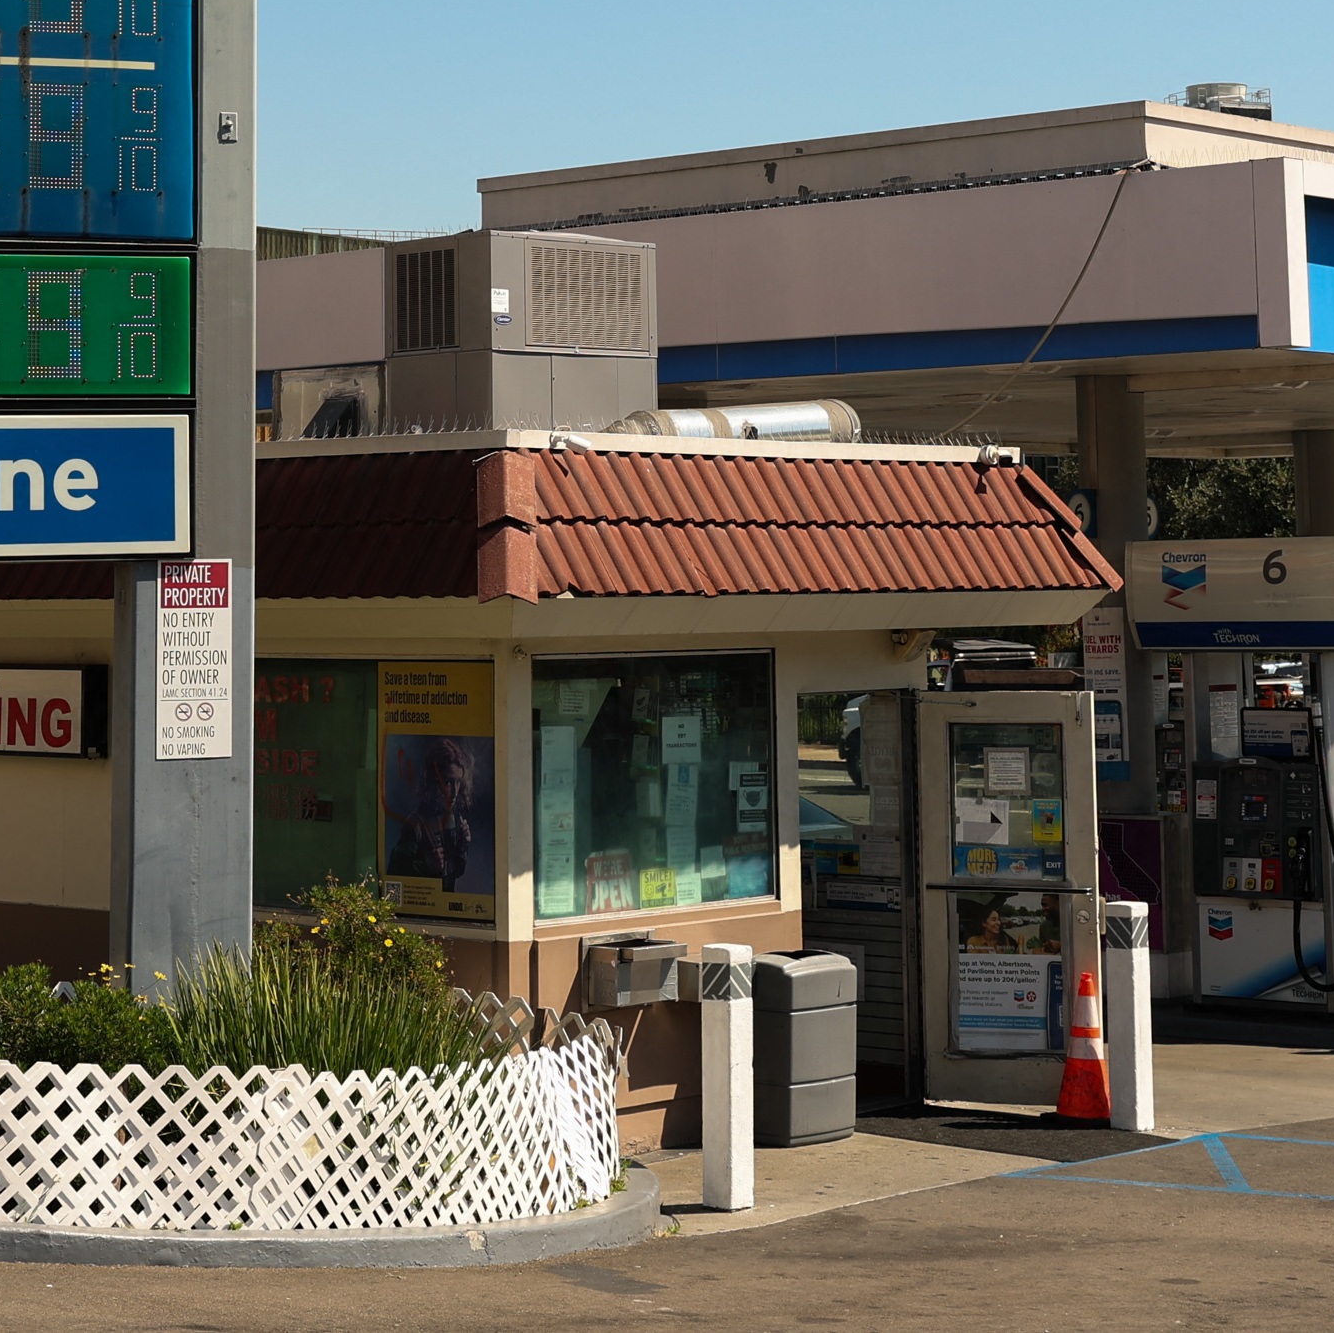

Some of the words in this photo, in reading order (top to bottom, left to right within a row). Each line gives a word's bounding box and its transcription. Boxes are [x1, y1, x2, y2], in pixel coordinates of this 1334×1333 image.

[164, 564, 212, 584] PRIVATE
[1161, 551, 1207, 564] Chevron
[1262, 549, 1287, 585] 6
[164, 587, 226, 606] PROPERTY
[163, 612, 179, 628] NO
[182, 611, 215, 627] ENTRY
[162, 631, 211, 646] WITHOUT
[1098, 634, 1121, 644] WITH
[1213, 633, 1260, 645] TECHRON
[1085, 644, 1119, 654] REWARDS
[162, 650, 227, 666] PERMISSION
[162, 669, 176, 685] OF
[180, 669, 219, 685] OWNER
[384, 671, 403, 686] Save
[404, 674, 409, 686] a
[409, 672, 427, 686] teen
[428, 672, 447, 686] from
[162, 688, 179, 698] LAMC
[180, 687, 207, 698] SECTION
[208, 687, 228, 697] 41.24
[320, 675, 335, 704] ?
[390, 691, 420, 705] lifetime
[421, 691, 430, 705] of
[431, 691, 468, 705] addiction
[384, 709, 399, 723] and
[400, 709, 432, 724] disease.
[162, 726, 174, 738] NO
[177, 725, 215, 738] SMOKING
[162, 744, 174, 756] NO
[177, 743, 206, 756] VAPING
[967, 848, 997, 862] MORE
[967, 862, 997, 876] MEGA
[644, 871, 673, 883] SMILE!
[1105, 892, 1121, 901] has
[1207, 908, 1233, 916] Chevron
[1291, 989, 1325, 1000] TECHRON
